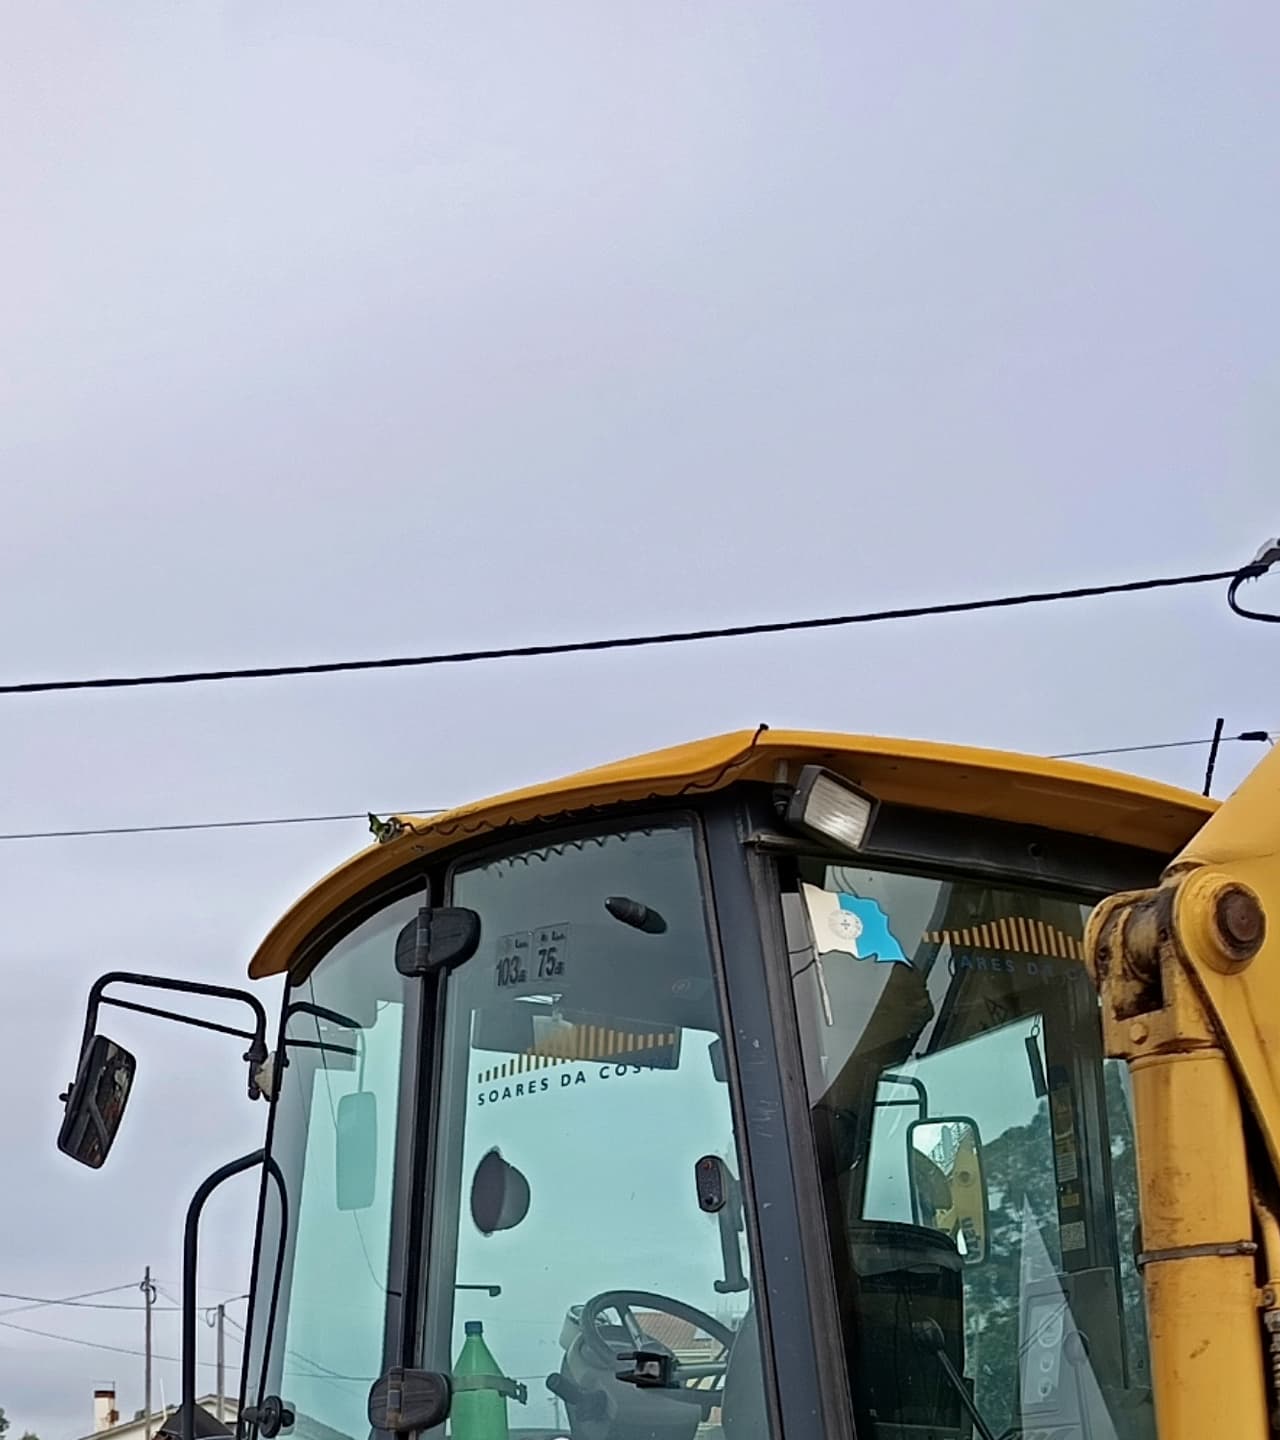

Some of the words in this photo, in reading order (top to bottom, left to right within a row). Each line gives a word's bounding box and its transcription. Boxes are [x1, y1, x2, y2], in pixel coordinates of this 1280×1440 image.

[496, 956, 520, 987] 103
[538, 946, 558, 977] 75
[477, 1077, 549, 1106] SOARES
[561, 1070, 586, 1088] DA
